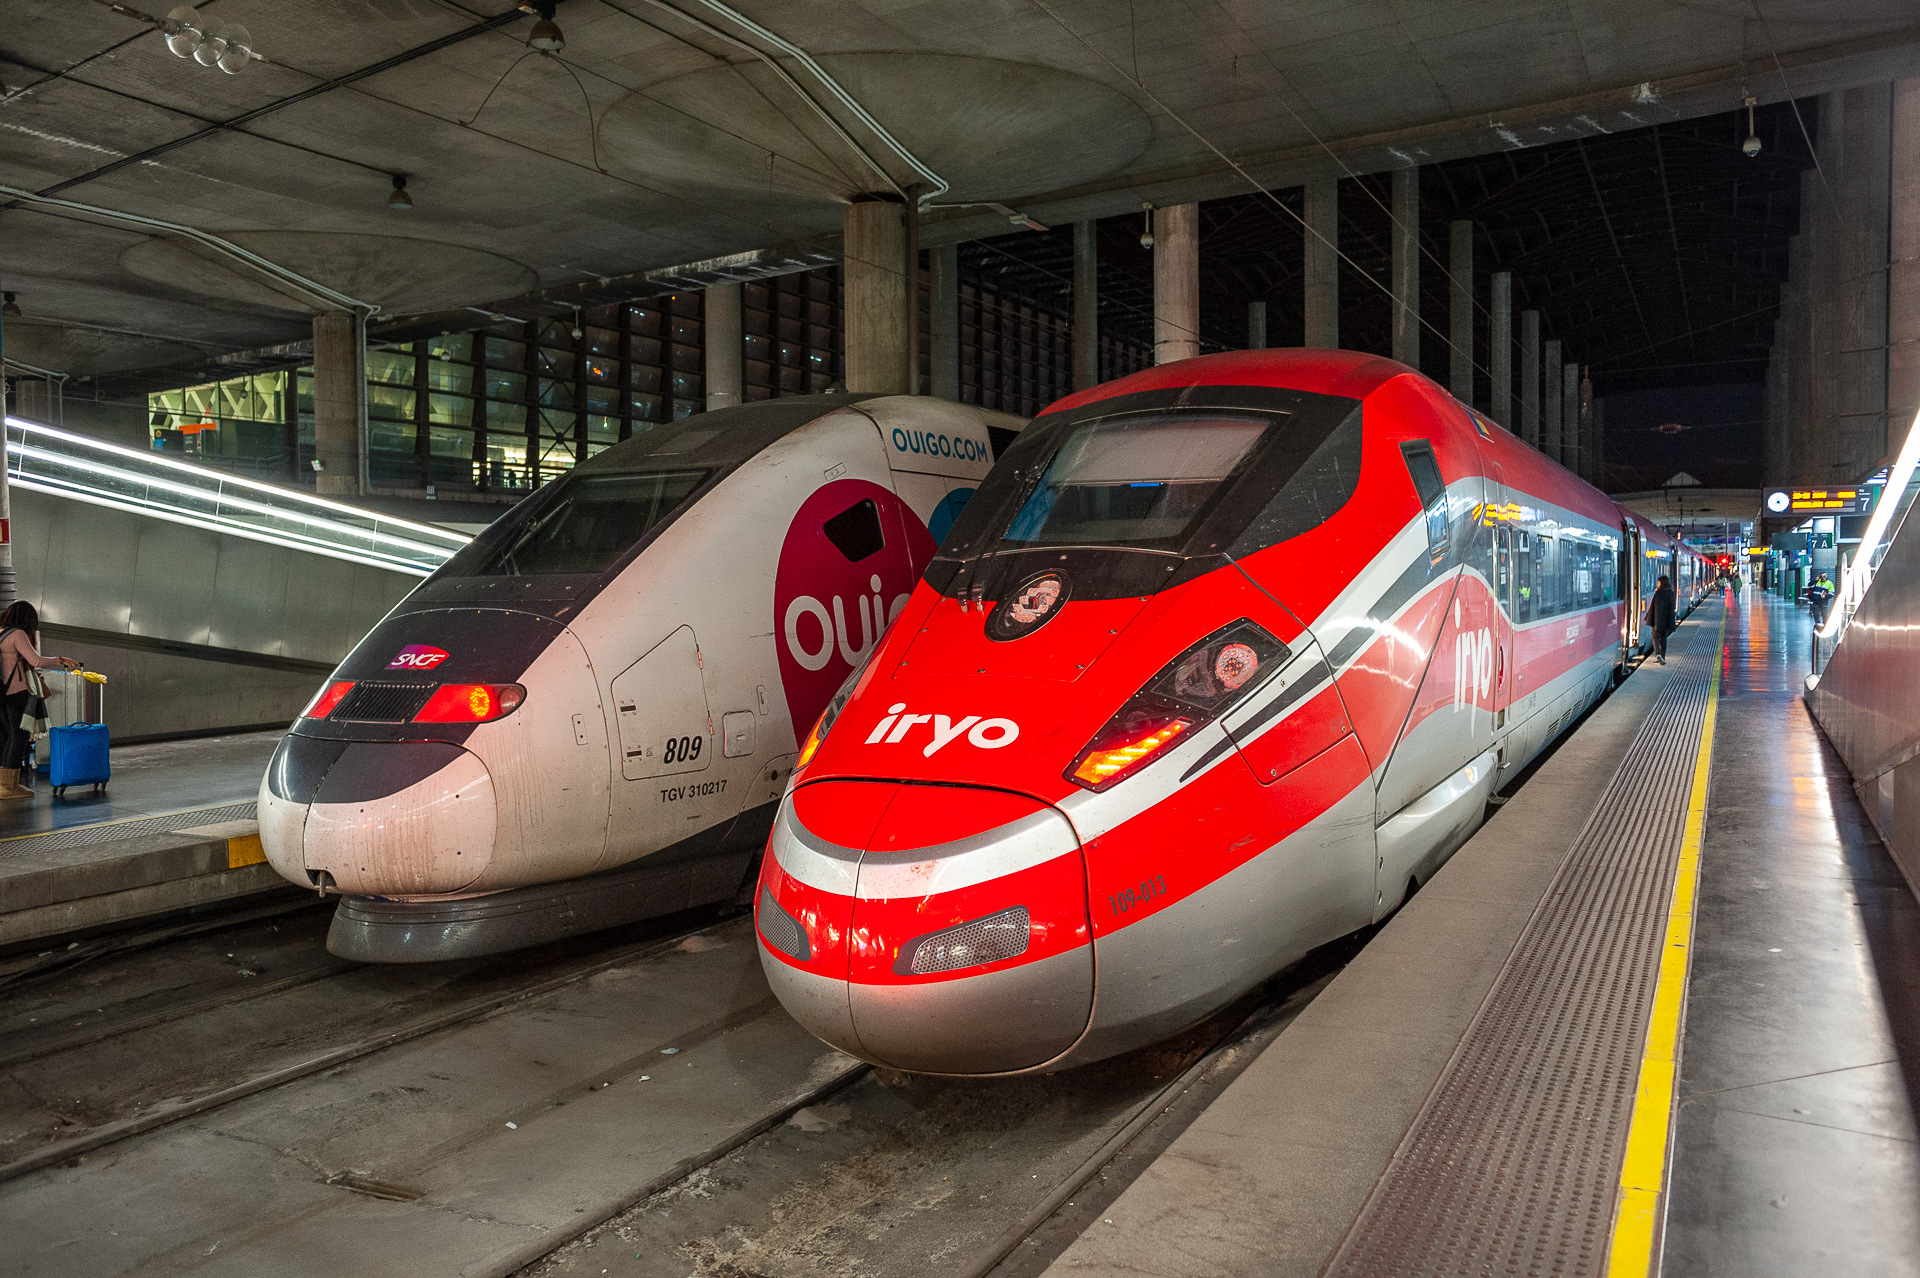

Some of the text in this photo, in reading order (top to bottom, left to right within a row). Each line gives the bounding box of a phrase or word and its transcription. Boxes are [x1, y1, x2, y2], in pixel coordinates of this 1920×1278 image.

[892, 428, 988, 463] OUIGO.COM
[1860, 497, 1870, 512] 7
[1811, 539, 1828, 548] 7 A
[784, 573, 912, 671] oui
[391, 653, 446, 667] SNCF
[1453, 597, 1492, 738] iryo
[864, 702, 1020, 758] iryo
[663, 736, 702, 764] 809
[660, 780, 728, 803] TGV 310217
[1108, 874, 1167, 916] 109-013
